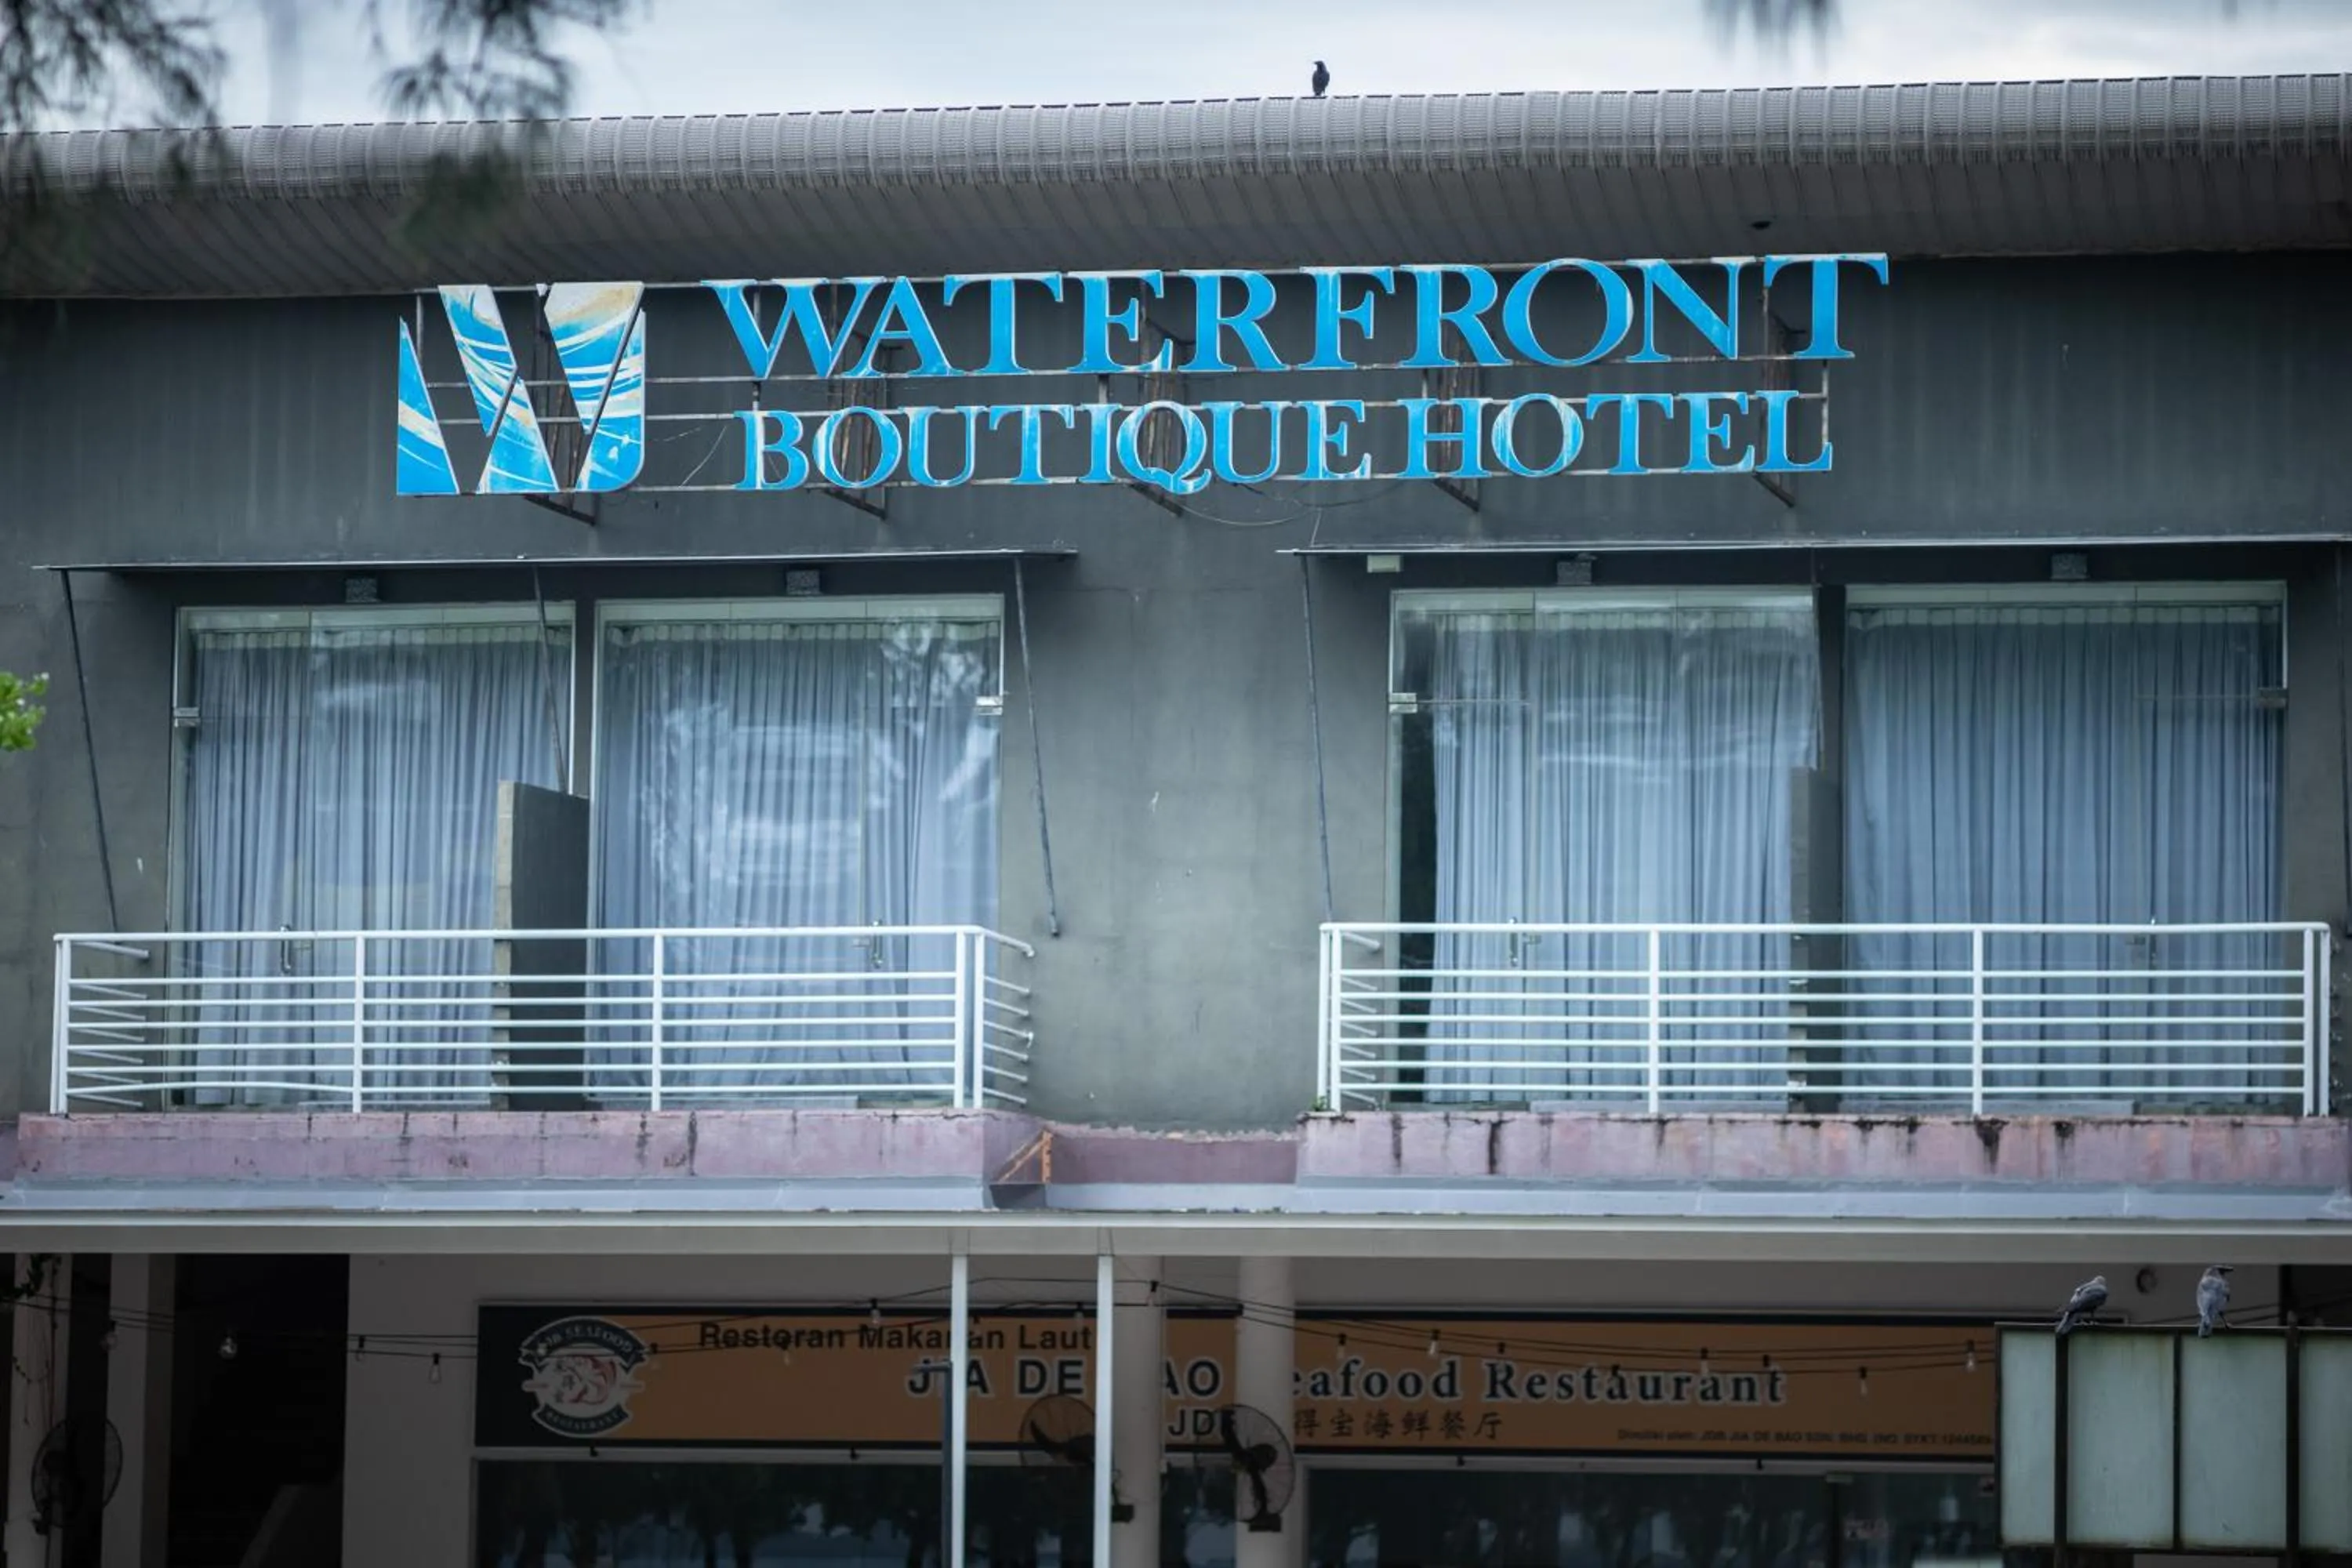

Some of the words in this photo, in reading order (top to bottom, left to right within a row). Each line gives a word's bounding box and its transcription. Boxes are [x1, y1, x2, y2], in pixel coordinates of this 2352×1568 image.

[700, 252, 1889, 380] WATERFRONT
[733, 398, 1372, 495] BOUTIQUE
[1396, 390, 1833, 479] HOTEL
[698, 1321, 845, 1348] Restoran
[858, 1323, 1004, 1349] Makaan
[1018, 1324, 1092, 1349] Laut
[908, 1359, 989, 1395] JA
[1018, 1359, 1084, 1395] DE
[1485, 1361, 1782, 1403] Restaurant
[1774, 1431, 1803, 1443] BAO
